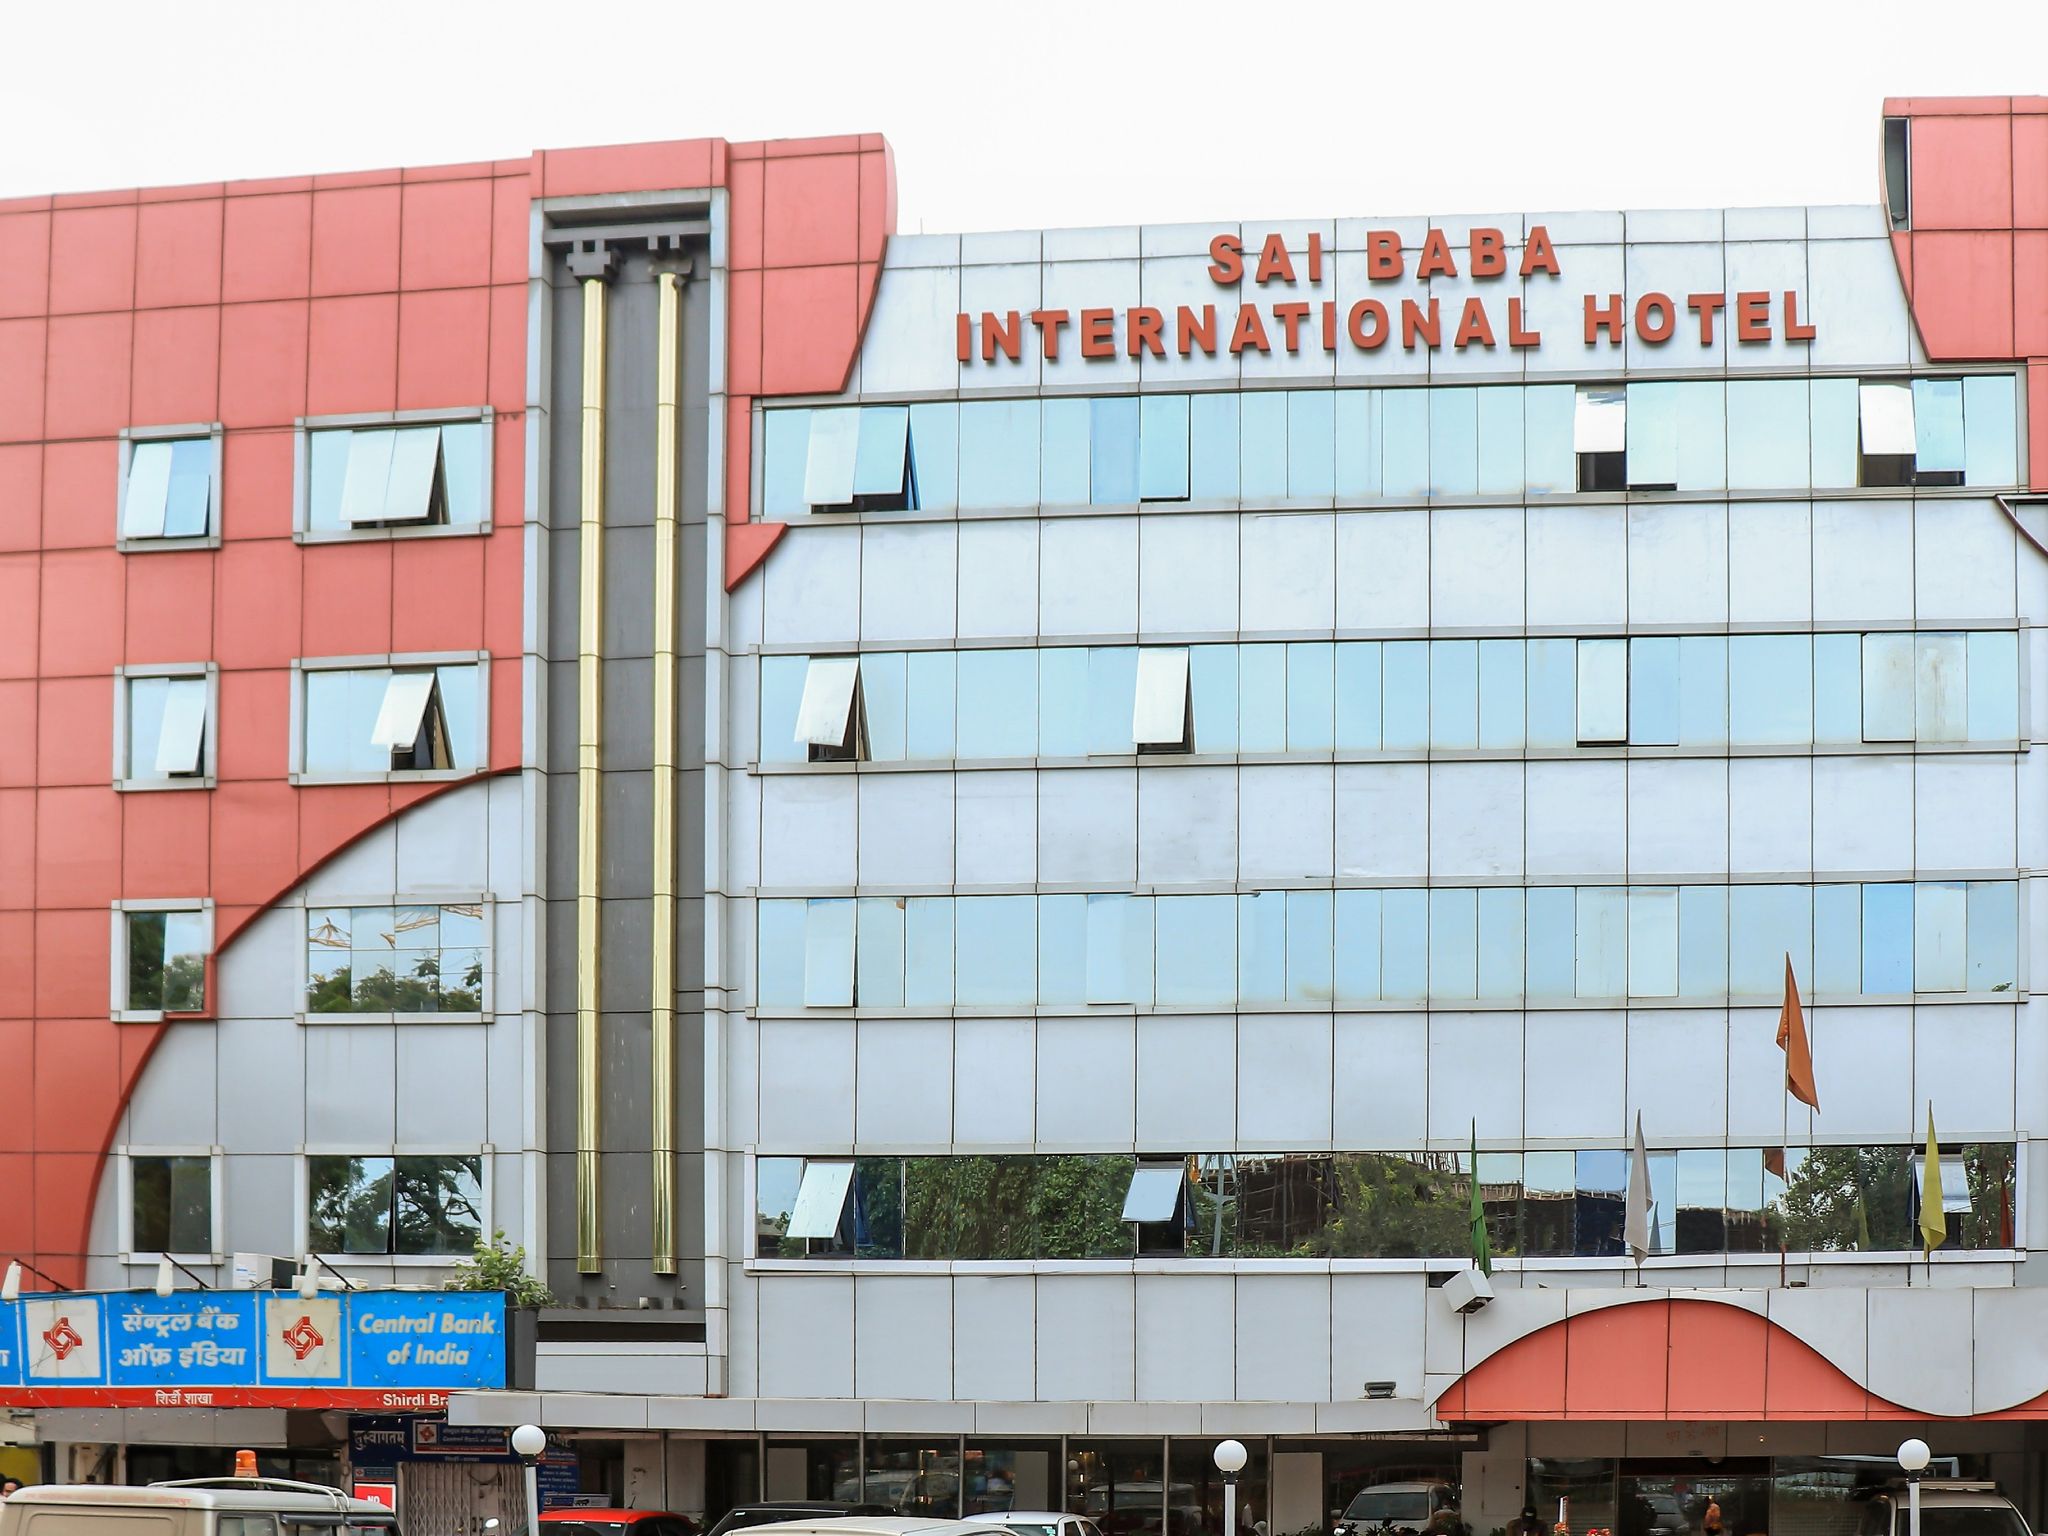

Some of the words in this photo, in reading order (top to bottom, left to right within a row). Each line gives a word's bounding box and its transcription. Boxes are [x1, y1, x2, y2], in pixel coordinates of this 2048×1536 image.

[1207, 232, 1322, 284] SAI
[1366, 225, 1560, 281] BABA
[956, 296, 1541, 361] INTERNATIONAL
[1583, 290, 1817, 346] HOTEL
[359, 1312, 436, 1334] Central
[440, 1311, 496, 1334] Bank
[178, 1340, 247, 1368] इंडिया
[387, 1342, 412, 1365] of
[415, 1343, 469, 1365] India
[184, 1393, 213, 1405] शाखा
[383, 1393, 424, 1406] Shirdi
